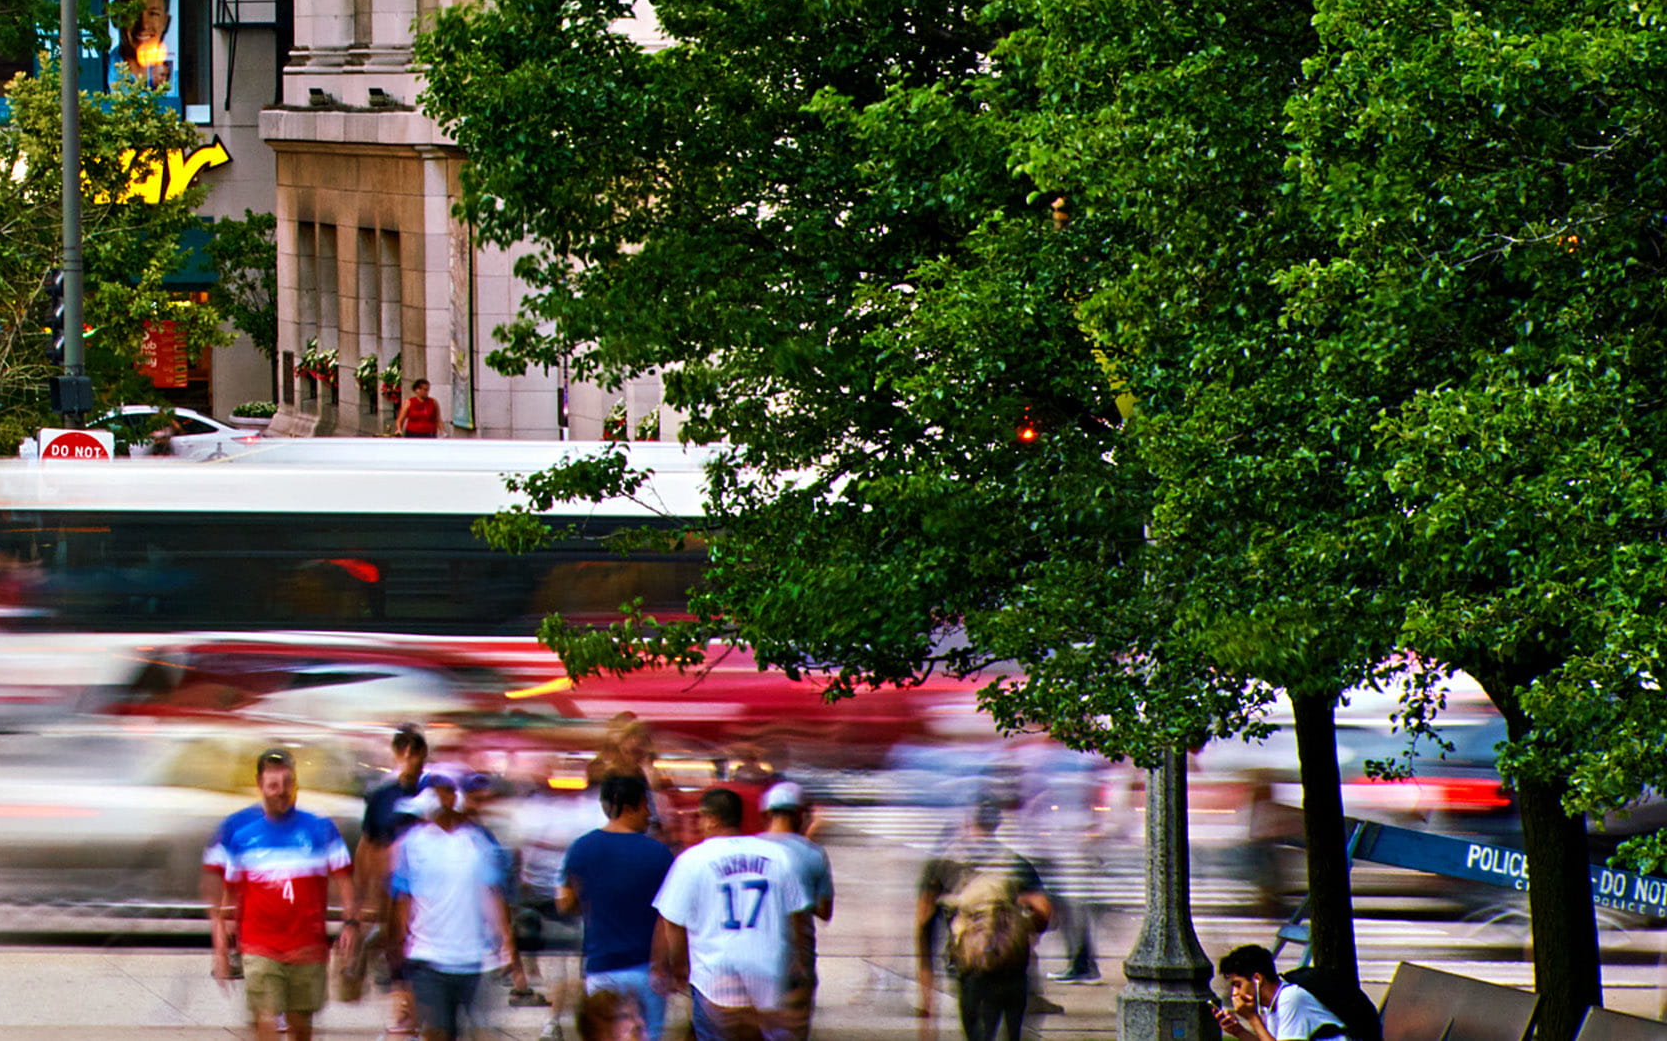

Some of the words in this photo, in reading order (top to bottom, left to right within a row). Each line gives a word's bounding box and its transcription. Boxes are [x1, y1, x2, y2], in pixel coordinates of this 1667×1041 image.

[51, 444, 69, 457] DO
[75, 446, 101, 459] NOT
[282, 880, 295, 905] 4
[1467, 844, 1530, 879] POLICE
[1599, 870, 1627, 897] DO
[1634, 877, 1667, 907] NOT
[720, 878, 769, 930] 17
